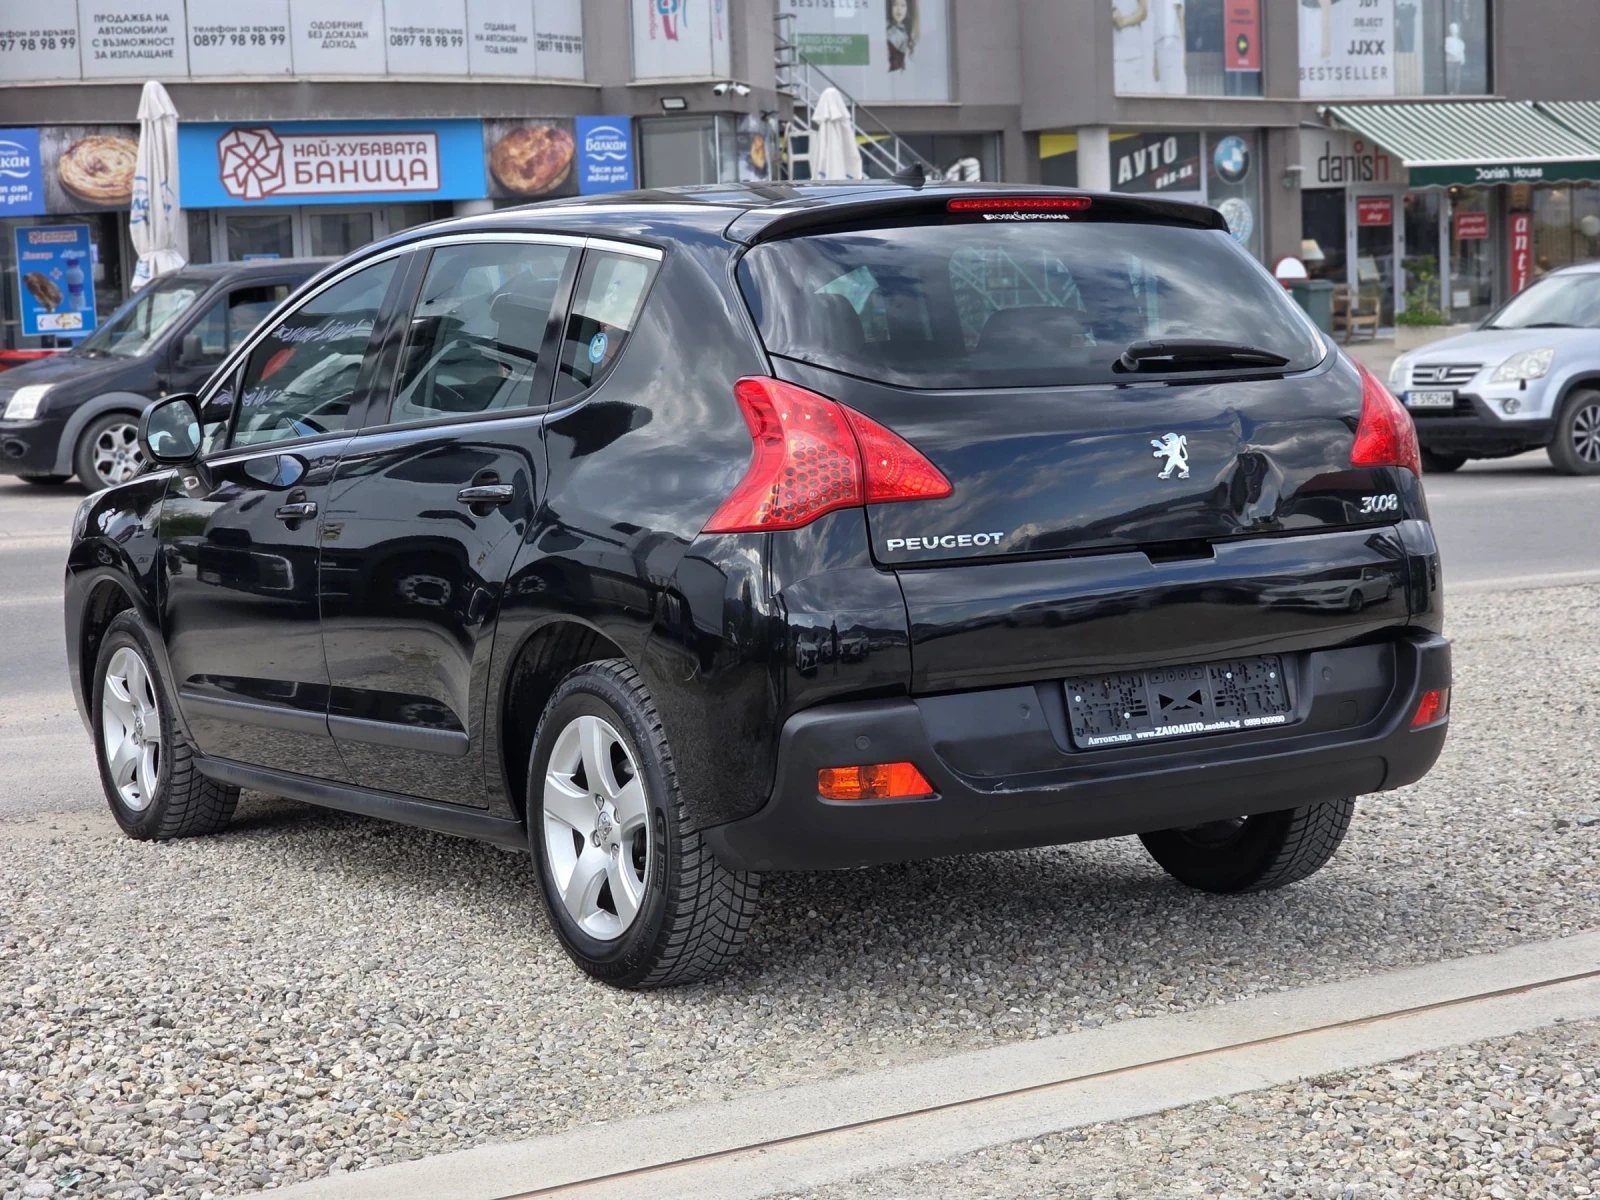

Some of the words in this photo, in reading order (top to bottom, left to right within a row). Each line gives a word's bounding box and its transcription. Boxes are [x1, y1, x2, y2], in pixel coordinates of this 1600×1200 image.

[790, 0, 869, 8] BESTSELLER
[93, 13, 153, 23] ПРОДАЖБА
[156, 13, 170, 22] НА
[98, 26, 168, 35] АВТОМОБИЛИ
[193, 25, 237, 34] телефон
[252, 26, 286, 34] връзка
[310, 21, 363, 30] ОДОБРЕНИЕ
[389, 26, 425, 34] телефон
[484, 23, 517, 32] ОТДАВАНЕ
[42, 29, 76, 37] връзка
[307, 30, 323, 39] БЕЗ
[325, 31, 369, 39] ДОКАЗАН
[485, 34, 528, 43] АВТОМОБИЛИ
[20, 39, 36, 51] 98
[40, 38, 56, 50] 98
[60, 37, 76, 49] 99
[91, 39, 100, 47] С
[103, 37, 175, 47] ВЪЗМОЖНОСТ
[193, 34, 226, 46] 0897
[230, 34, 246, 46] 98
[250, 34, 266, 46] 98
[270, 33, 285, 46] 99
[321, 40, 357, 49] ДОХОД
[390, 35, 416, 46] 0897
[419, 35, 432, 47] 98
[435, 35, 448, 47] 98
[450, 36, 463, 47] 99
[537, 40, 553, 51] 0897
[1347, 40, 1385, 55] JJXX
[95, 51, 108, 60] ЗА
[110, 49, 174, 59] ИЗПЛАЩАНЕ
[1299, 66, 1388, 81] BESTSELLER
[293, 140, 428, 157] НАЙ-ХУБАВАТА
[585, 138, 627, 151] Балкан
[1318, 140, 1389, 183] danish
[294, 158, 428, 187] БАНИЦА
[1513, 166, 1543, 178] House
[1360, 493, 1398, 513] 3008
[886, 532, 1004, 552] PEUGEOT
[1088, 733, 1133, 746] Автокъща
